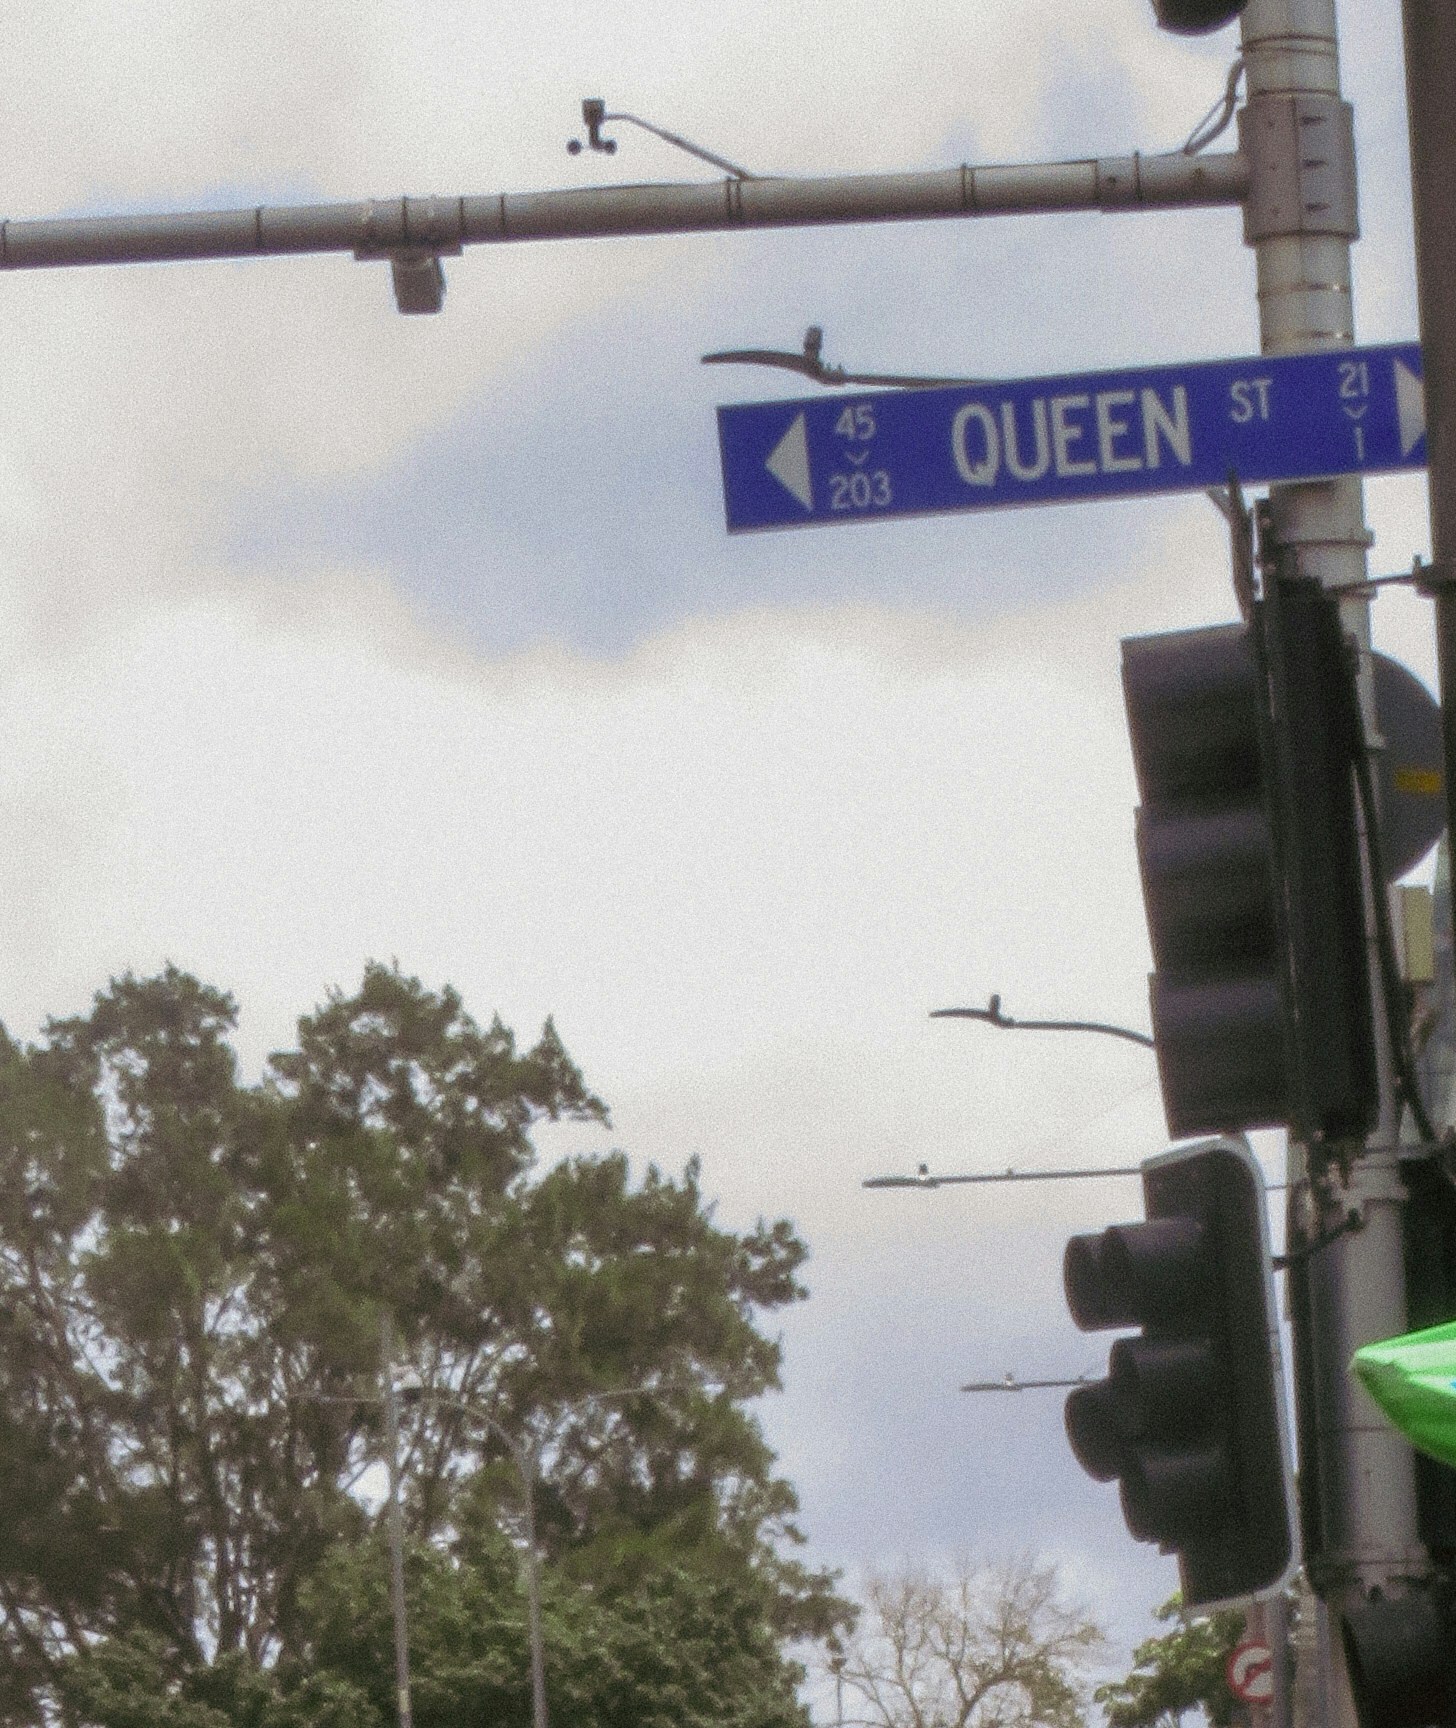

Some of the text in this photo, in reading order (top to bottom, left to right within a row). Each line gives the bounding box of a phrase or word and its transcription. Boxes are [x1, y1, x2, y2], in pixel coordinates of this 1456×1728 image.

[1339, 361, 1371, 399] 21
[833, 405, 877, 443] 45
[950, 380, 1273, 487] QUEEN ST
[1353, 426, 1367, 460] 1
[829, 473, 893, 511] 203
